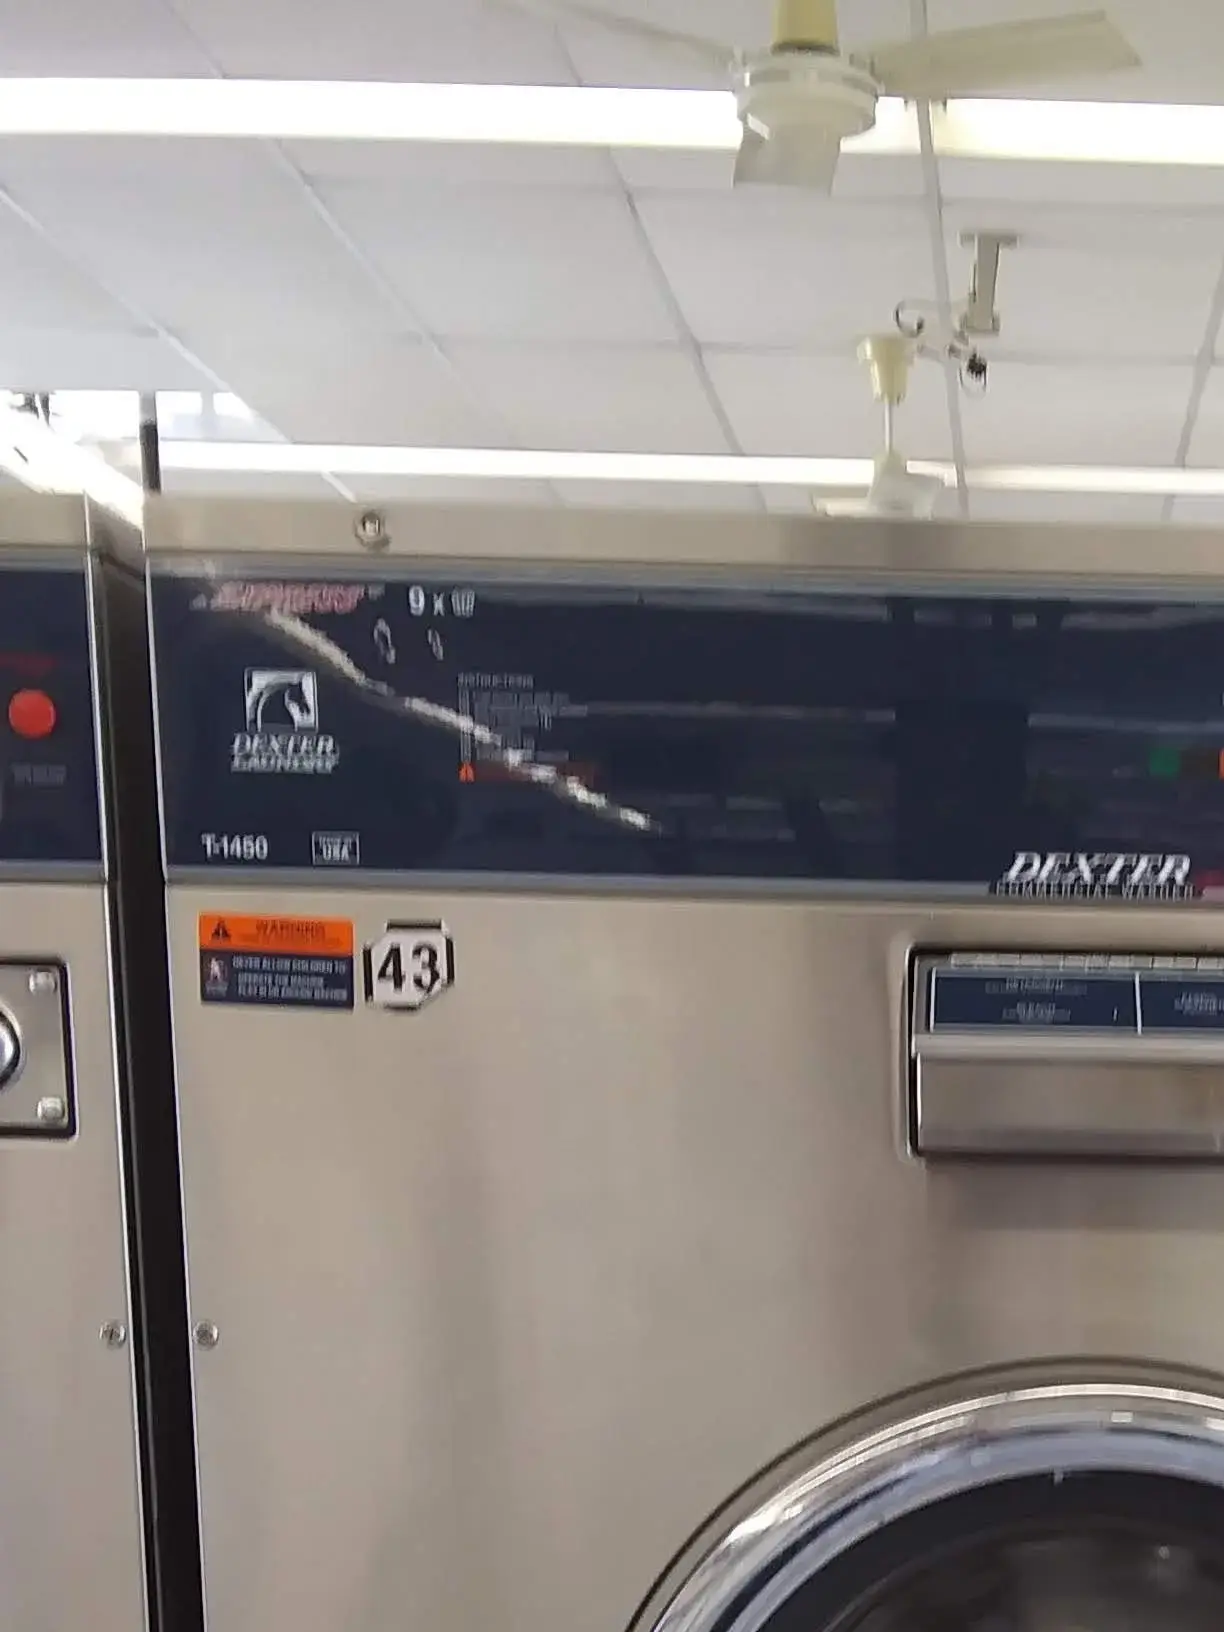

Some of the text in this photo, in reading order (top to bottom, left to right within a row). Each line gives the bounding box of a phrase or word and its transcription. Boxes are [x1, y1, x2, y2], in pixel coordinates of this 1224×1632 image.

[408, 585, 426, 617] 9
[232, 733, 335, 754] DEXTER
[1002, 852, 1191, 885] DEXTER
[377, 942, 441, 995] 43
